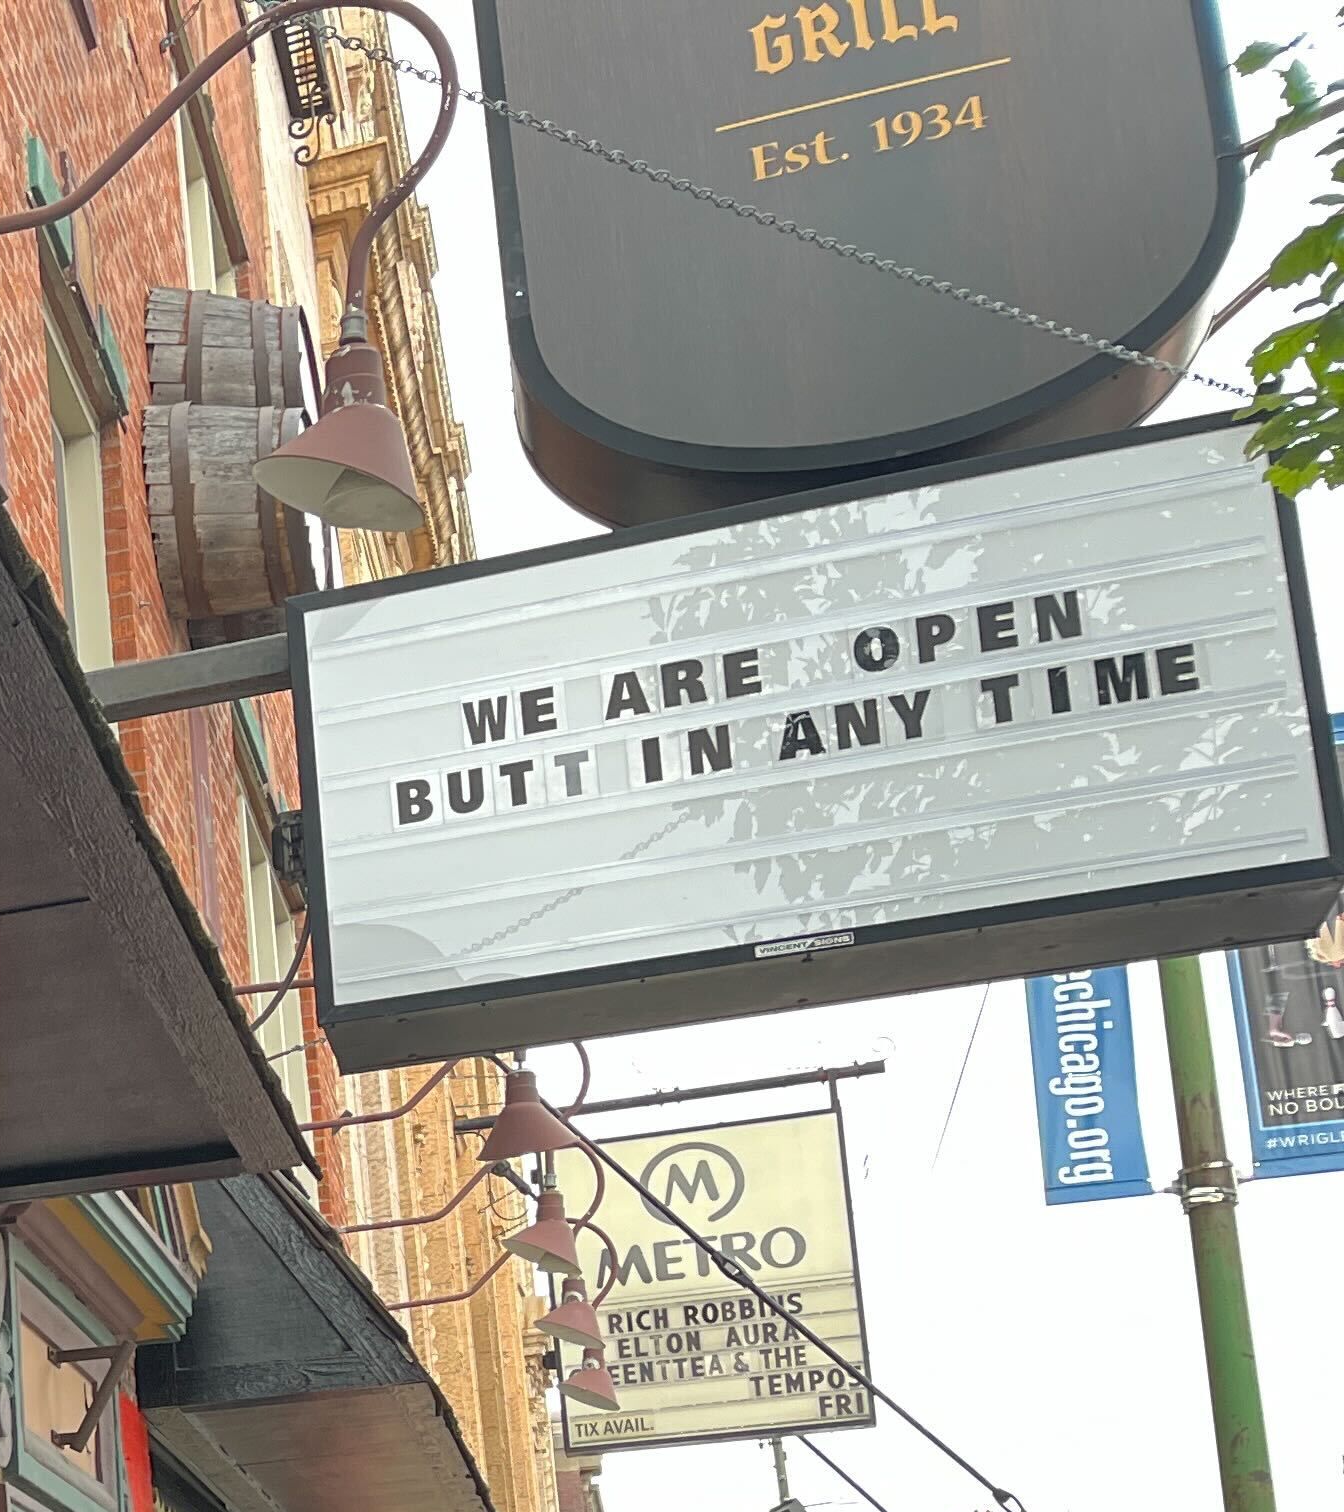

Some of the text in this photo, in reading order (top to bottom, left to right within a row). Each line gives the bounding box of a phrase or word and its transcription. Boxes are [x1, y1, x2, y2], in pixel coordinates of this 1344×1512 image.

[747, 0, 959, 74] GRILL
[751, 95, 989, 181] Est. 1934
[461, 589, 1083, 746] WE ARE OPEN
[395, 643, 1201, 826] BUTT IN ANY TIME
[759, 934, 851, 955] VINCENT SIGNS
[1267, 1085, 1329, 1101] WHERE
[1269, 1102, 1299, 1117] NO
[1265, 1130, 1344, 1150] #WRIGL
[597, 1226, 807, 1290] METRO
[608, 1292, 804, 1335] RICH ROBBINS
[617, 1320, 801, 1360] ELTON AURA
[569, 1345, 808, 1386] EENTTEA & THE
[818, 1392, 865, 1417] FRI
[575, 1416, 655, 1438] TIX AVAIL.
